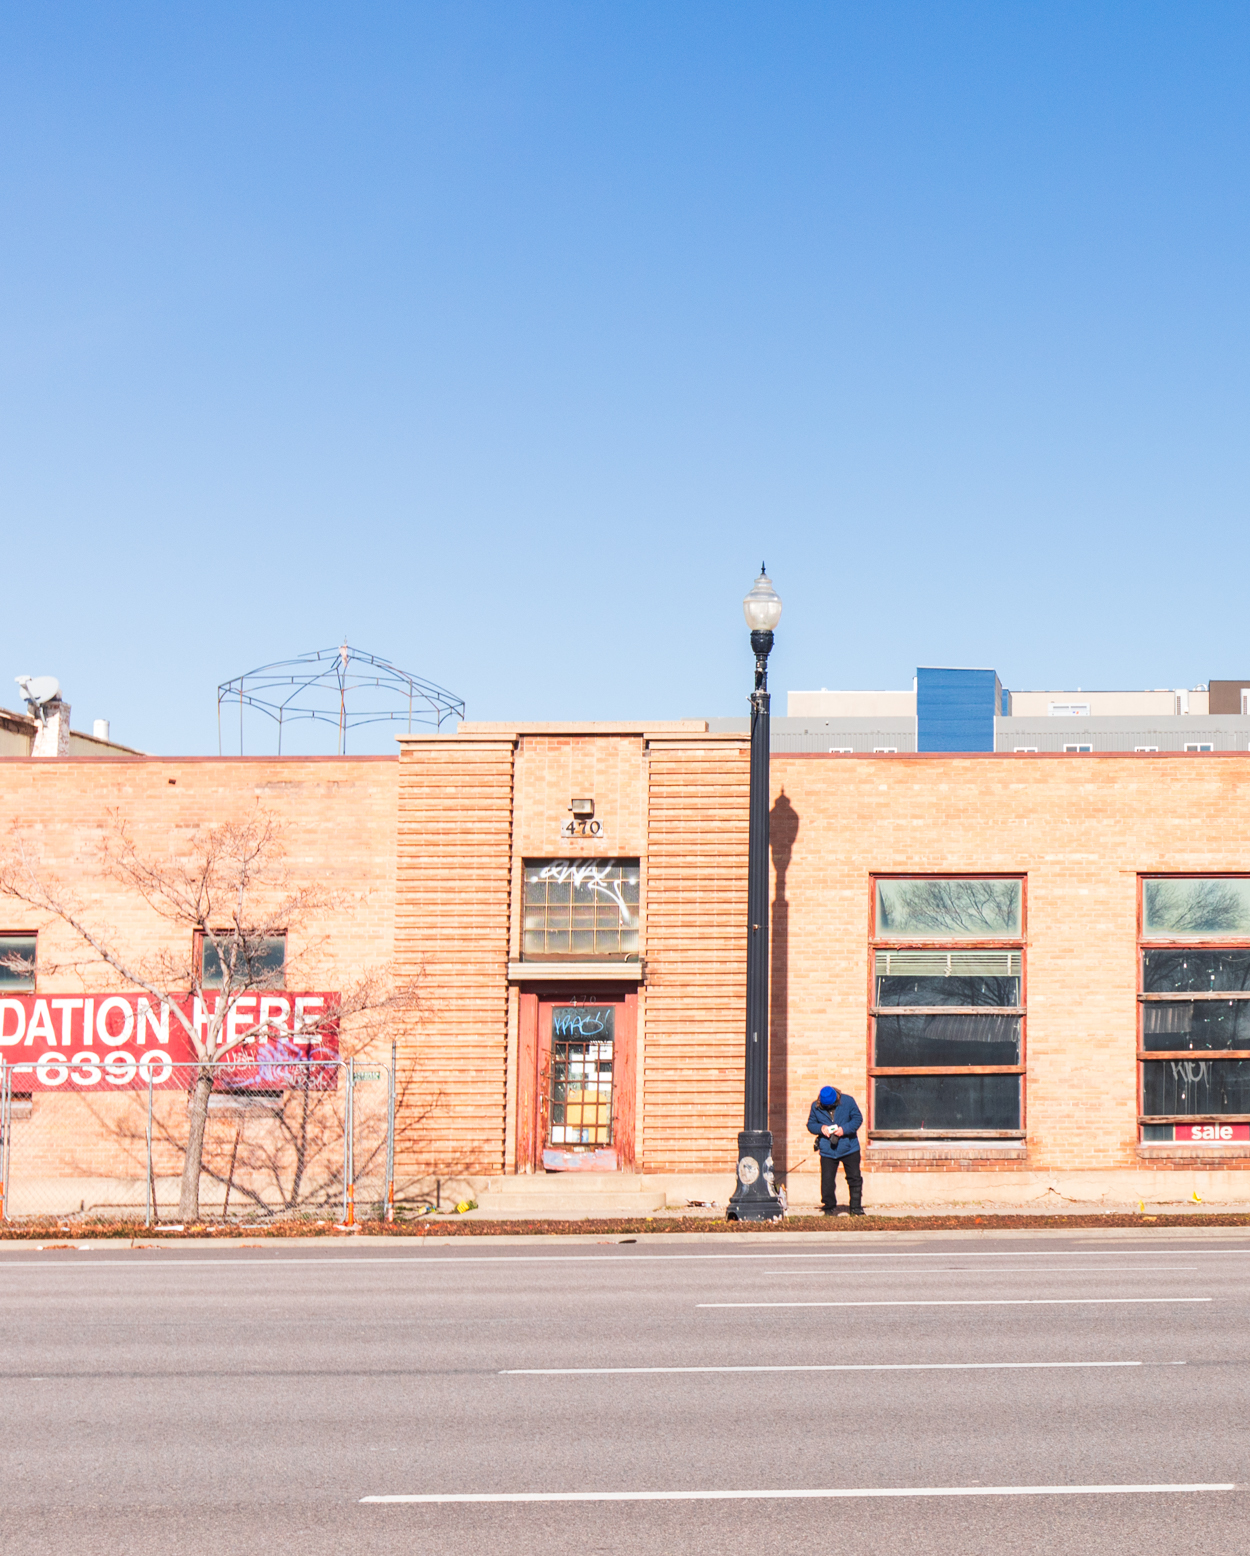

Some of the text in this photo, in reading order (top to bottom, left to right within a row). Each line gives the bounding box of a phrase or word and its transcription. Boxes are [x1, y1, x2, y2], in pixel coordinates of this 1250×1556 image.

[566, 821, 601, 835] 470
[569, 995, 597, 1007] 470
[0, 996, 324, 1046] DATION HERE
[0, 1049, 173, 1086] -6390
[1191, 1122, 1234, 1139] sale
